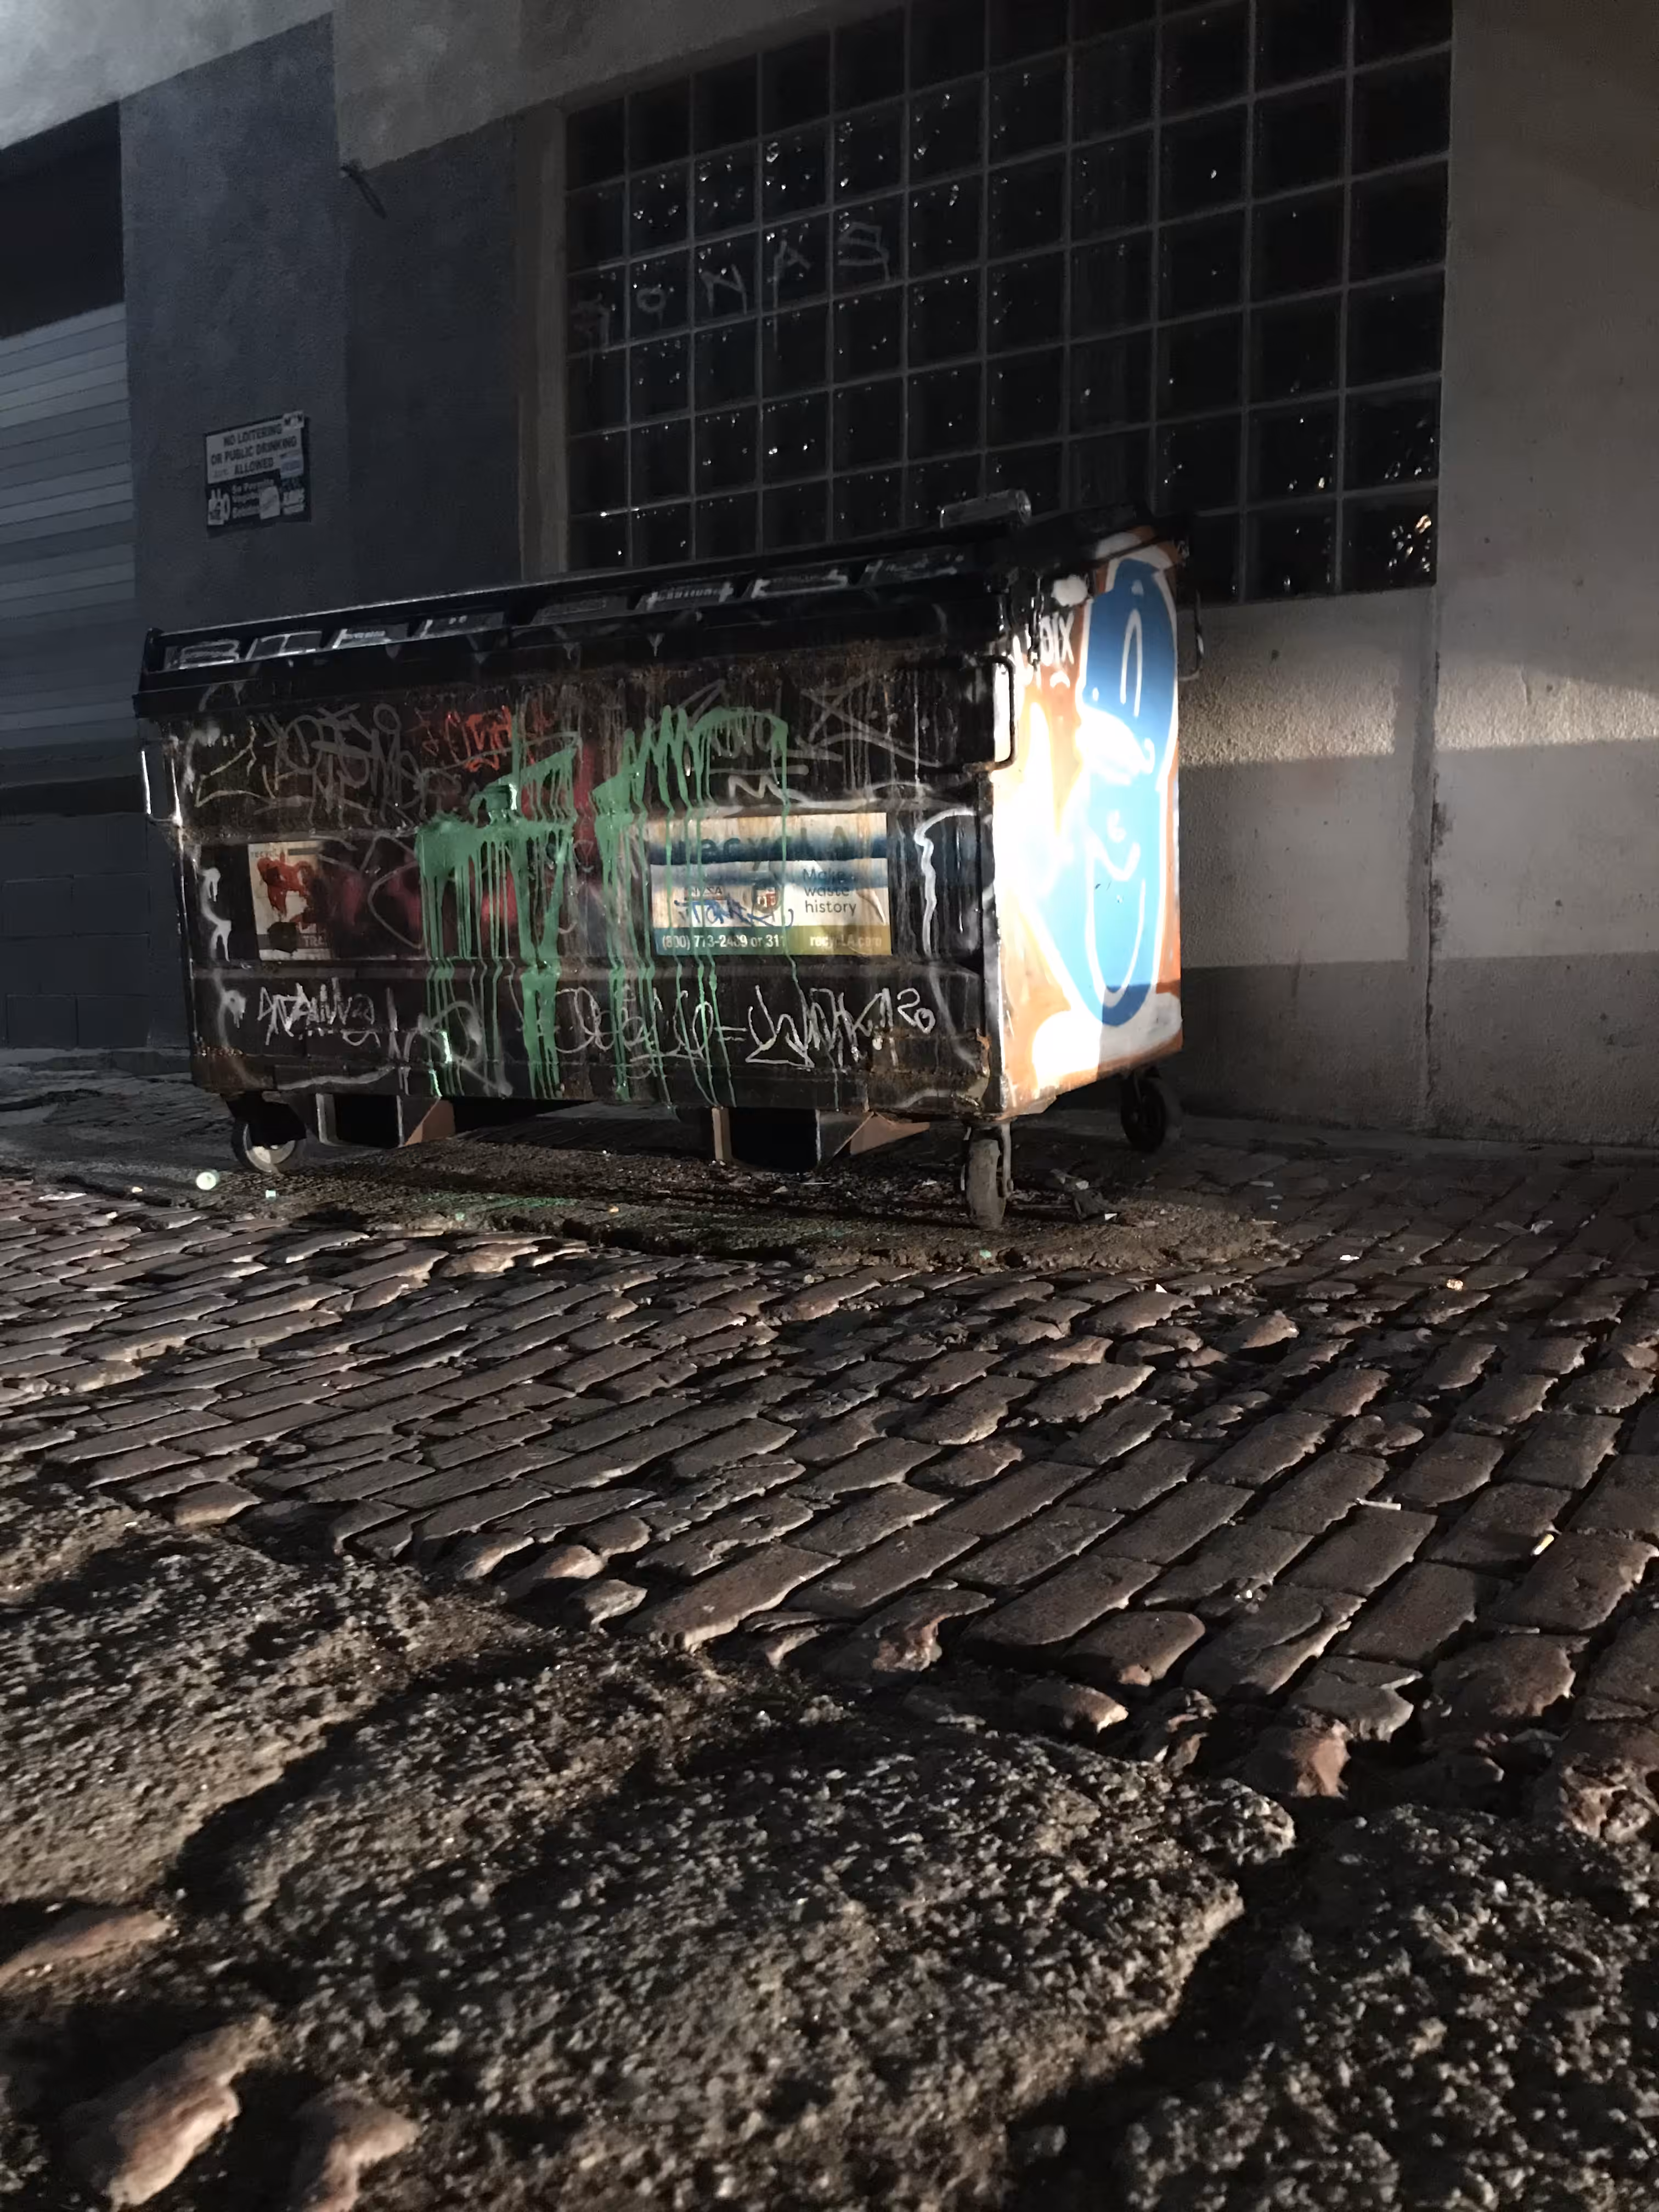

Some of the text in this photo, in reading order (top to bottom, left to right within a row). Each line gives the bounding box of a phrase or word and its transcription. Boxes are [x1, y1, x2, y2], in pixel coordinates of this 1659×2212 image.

[223, 424, 282, 447] NO LOITERING
[211, 436, 296, 465] OR PUBLIC DRINKING
[235, 458, 273, 475] ALLOWED
[803, 868, 845, 883] Make
[805, 884, 850, 897] waste
[805, 900, 857, 914] history
[751, 937, 763, 947] or
